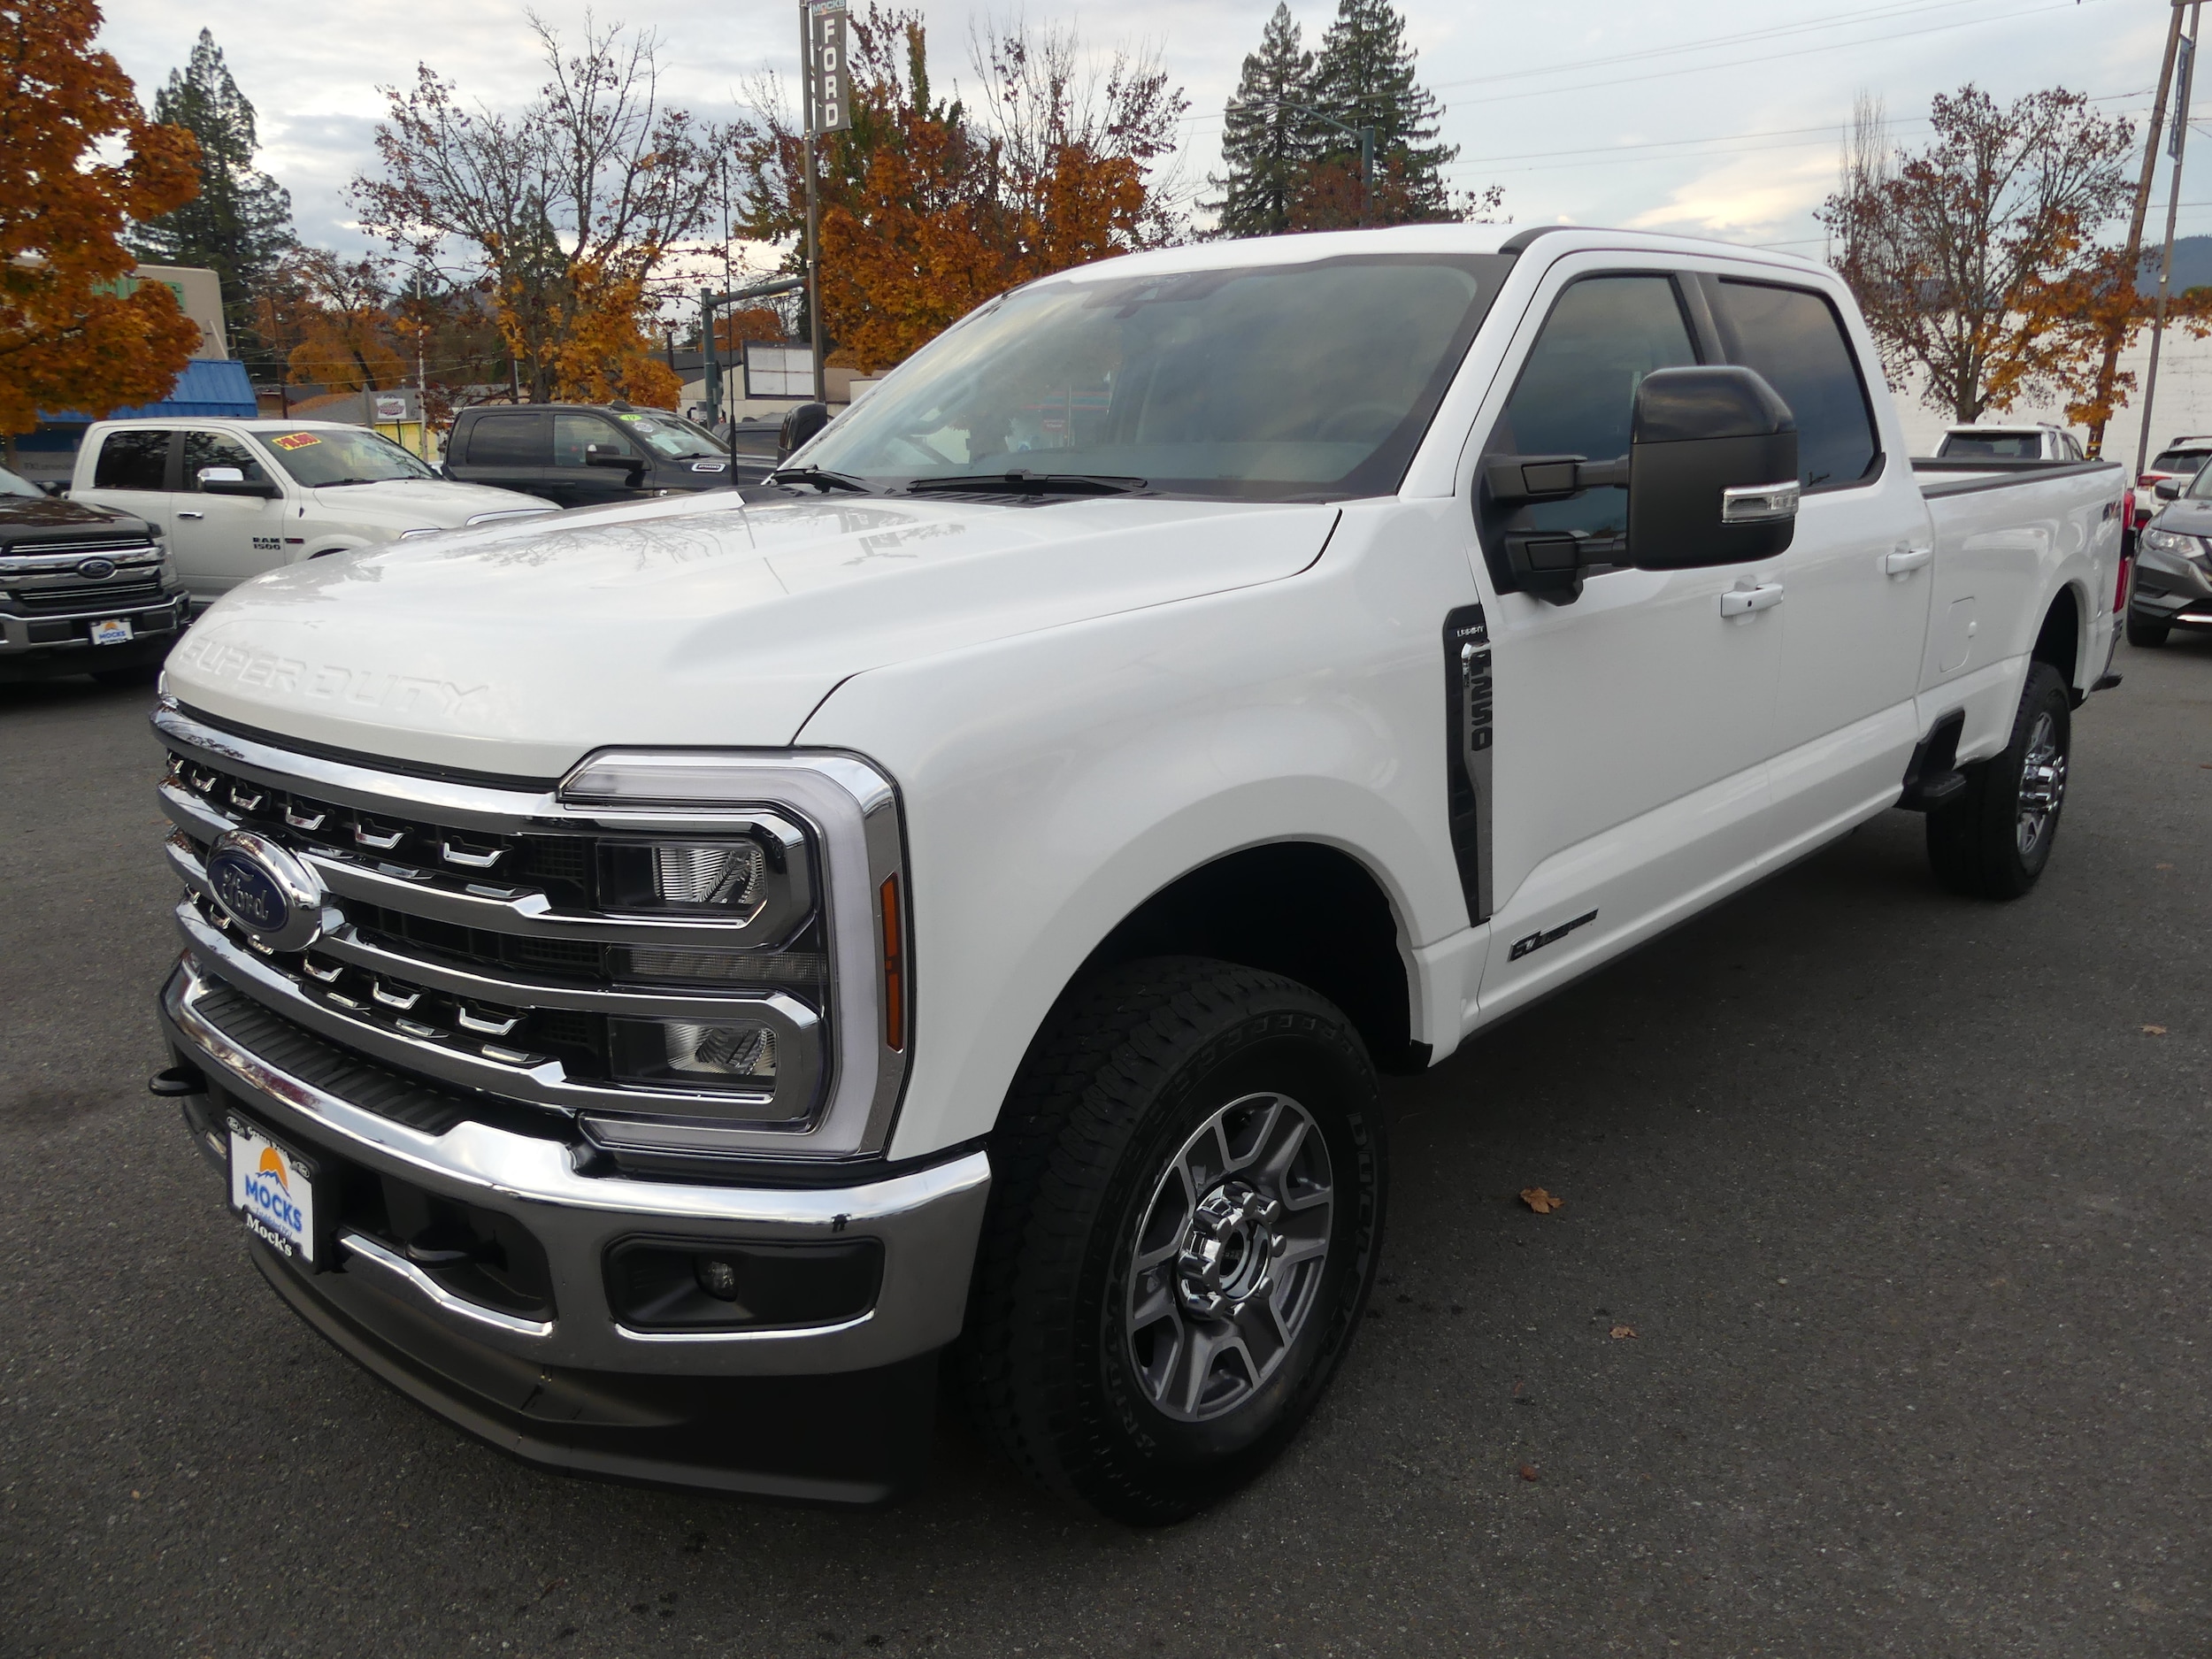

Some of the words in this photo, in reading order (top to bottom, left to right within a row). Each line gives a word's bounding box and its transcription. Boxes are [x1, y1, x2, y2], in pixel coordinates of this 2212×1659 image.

[824, 19, 839, 127] FORD
[179, 636, 308, 695] SUPER
[303, 664, 489, 716] DUTY
[222, 863, 270, 921] Ford
[245, 1173, 303, 1233] MOCKS
[246, 1213, 293, 1257] Mock's
